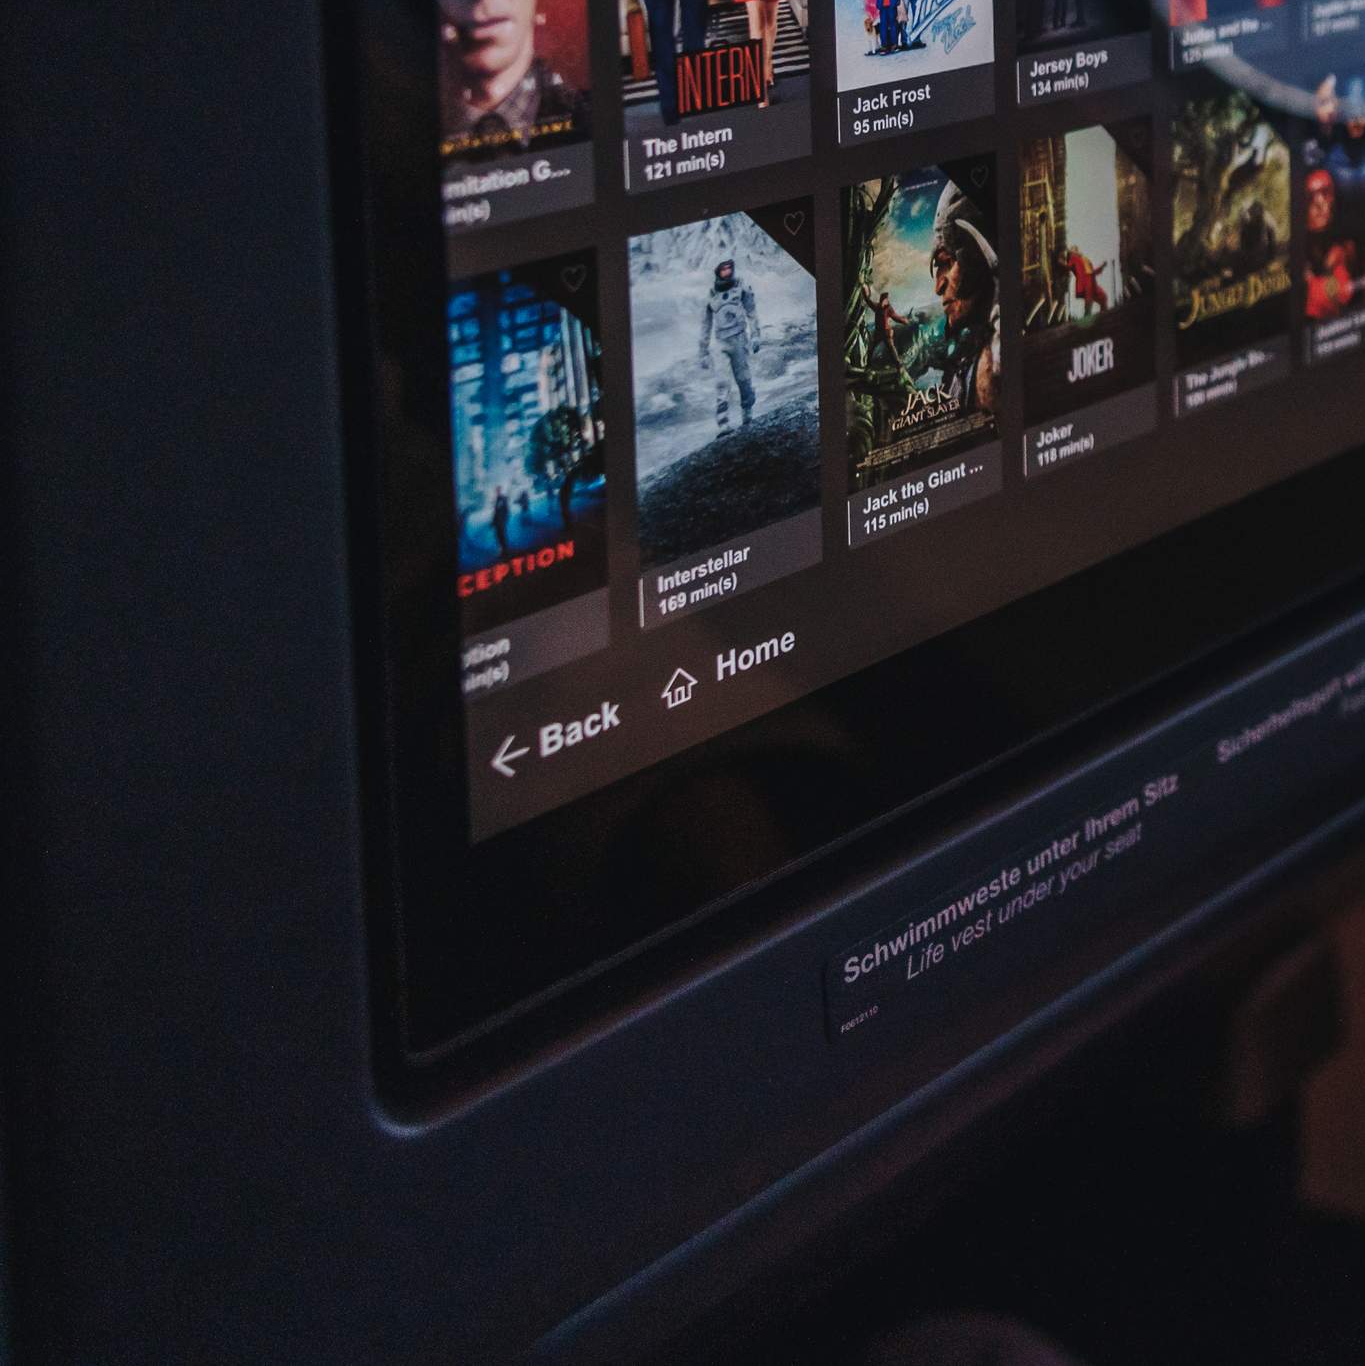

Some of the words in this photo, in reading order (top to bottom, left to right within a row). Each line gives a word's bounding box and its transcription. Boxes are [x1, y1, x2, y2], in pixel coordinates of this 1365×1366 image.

[677, 44, 761, 114] INTERN
[1030, 57, 1073, 77] Jersey
[1076, 49, 1109, 70] Boys
[853, 93, 888, 115] Jack
[893, 84, 931, 106] Frost
[1031, 80, 1052, 97] 134
[1054, 73, 1090, 92] min(s)
[853, 120, 870, 136] 95
[873, 109, 914, 132] min(s)
[642, 137, 678, 158] The
[681, 128, 733, 150] Intern
[644, 163, 672, 181] 121
[676, 149, 726, 173] min(s)
[1068, 337, 1114, 383] JOKER
[901, 383, 952, 416] JACK
[892, 413, 925, 432] GIANT
[1036, 423, 1074, 448] Joker
[1037, 449, 1057, 467] 118
[1059, 434, 1095, 458] min(s)
[863, 492, 897, 515] Jack
[901, 482, 924, 500] the
[928, 463, 966, 489] Giant
[864, 517, 887, 535] 115
[889, 497, 930, 526] min(s)
[657, 546, 751, 594] Interstellar
[659, 591, 688, 615] 169
[690, 572, 739, 605] min(s)
[716, 631, 796, 682] Home
[539, 701, 621, 759] Back
[844, 865, 1021, 984] Schwimmweste
[1027, 829, 1081, 874] unter
[1084, 796, 1140, 842] Ihrem
[1142, 774, 1181, 807] Sitz
[906, 941, 945, 981] Life
[951, 909, 994, 953] vest
[999, 877, 1057, 925] under
[1057, 850, 1102, 894] your
[1103, 822, 1143, 861] seat
